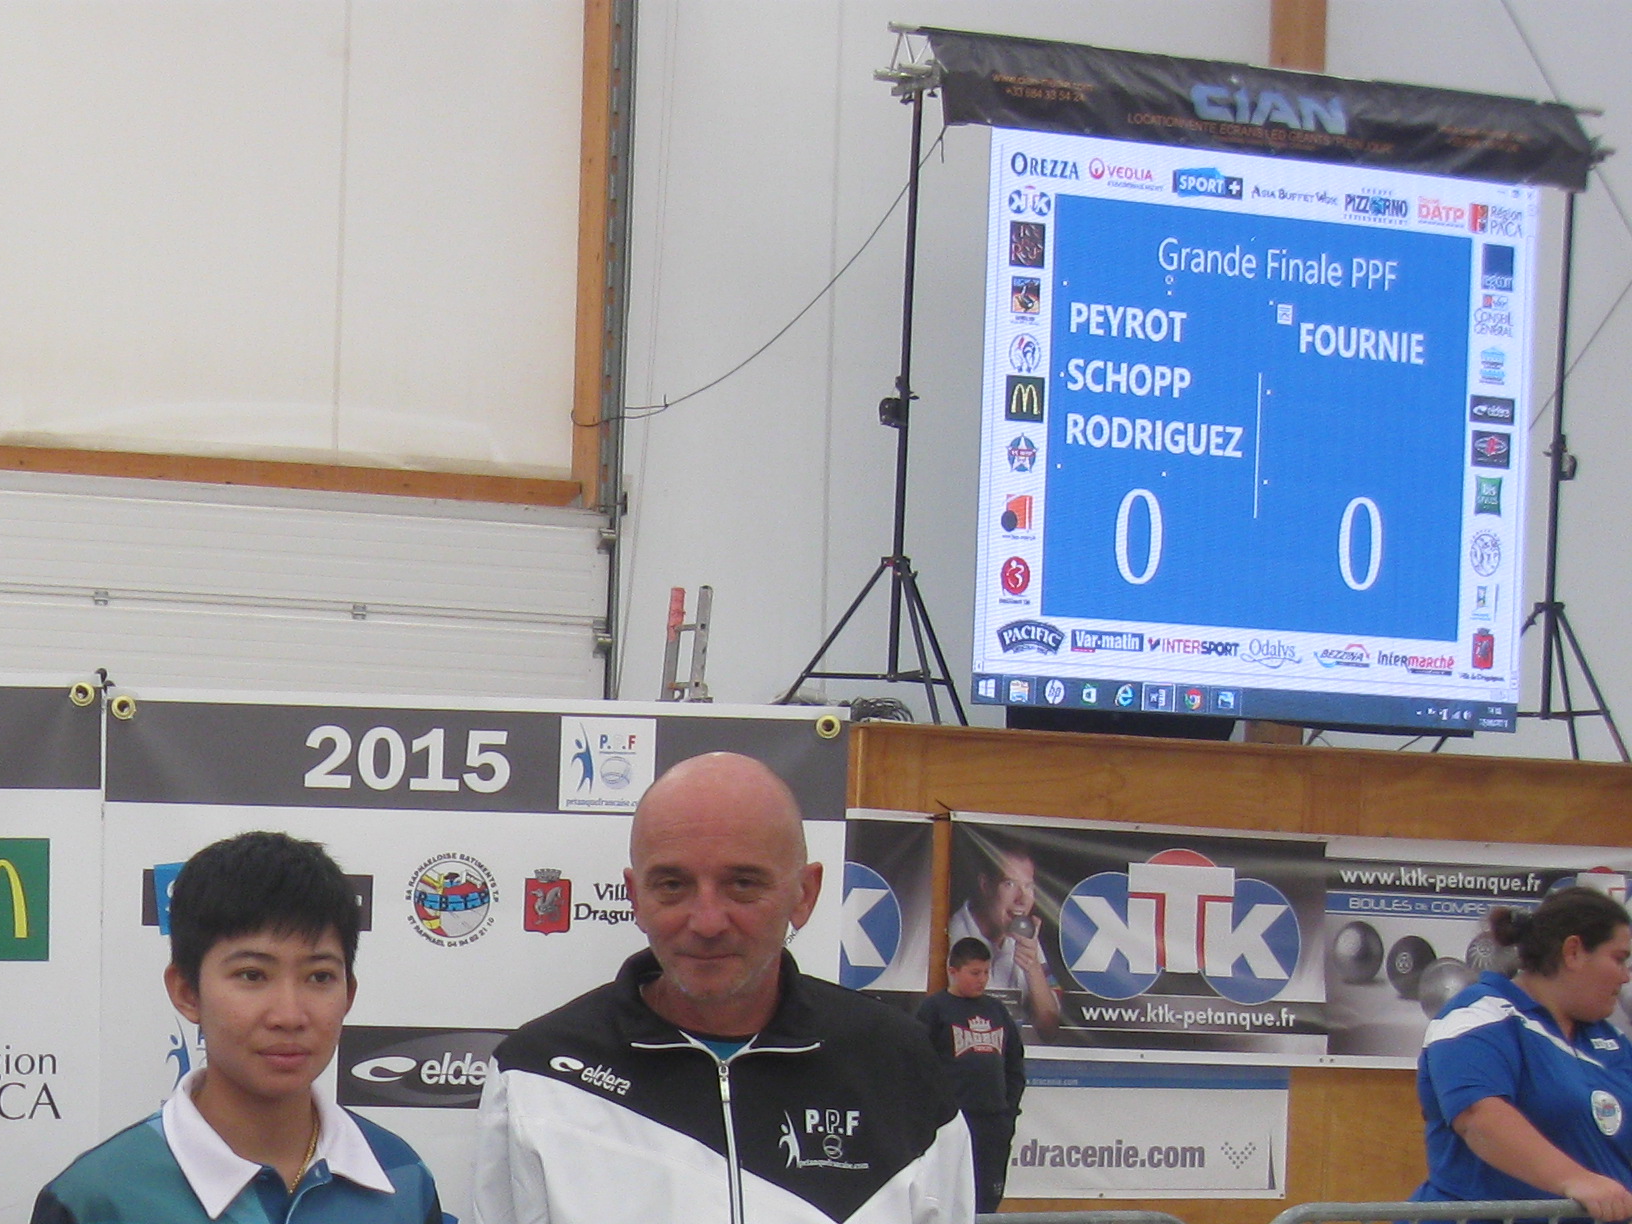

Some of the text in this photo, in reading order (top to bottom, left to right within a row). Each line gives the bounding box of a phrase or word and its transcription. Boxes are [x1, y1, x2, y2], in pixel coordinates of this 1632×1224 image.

[1011, 152, 1080, 181] OREZZA
[1179, 175, 1225, 194] SPORT
[1418, 203, 1465, 223] DATP
[1158, 237, 1399, 292] Grande Finale PPF
[1070, 301, 1187, 342] PEYROT
[1299, 322, 1425, 365] FOURNIE
[1066, 358, 1192, 398] SCHOPP
[1066, 412, 1244, 458] RODRIGUEZ
[1115, 488, 1163, 585] 0
[1338, 496, 1383, 591] 0
[1002, 624, 1062, 647] PACIFIC
[1162, 637, 1240, 657] INTERSPORT
[304, 724, 511, 793] 2015
[459, 853, 497, 889] BATIMENTS
[1339, 867, 1541, 894] www.ktk-petanque.fr
[593, 882, 631, 902] Vill
[1349, 897, 1412, 912] BOULES
[1063, 858, 1296, 990] KTK
[1081, 1003, 1296, 1030] www.ktk-petanque.fr
[420, 1052, 486, 1086] elde
[580, 1064, 632, 1096] eldera
[805, 1108, 860, 1136] P.P.F
[1011, 1139, 1206, 1169] .dracenie.com
